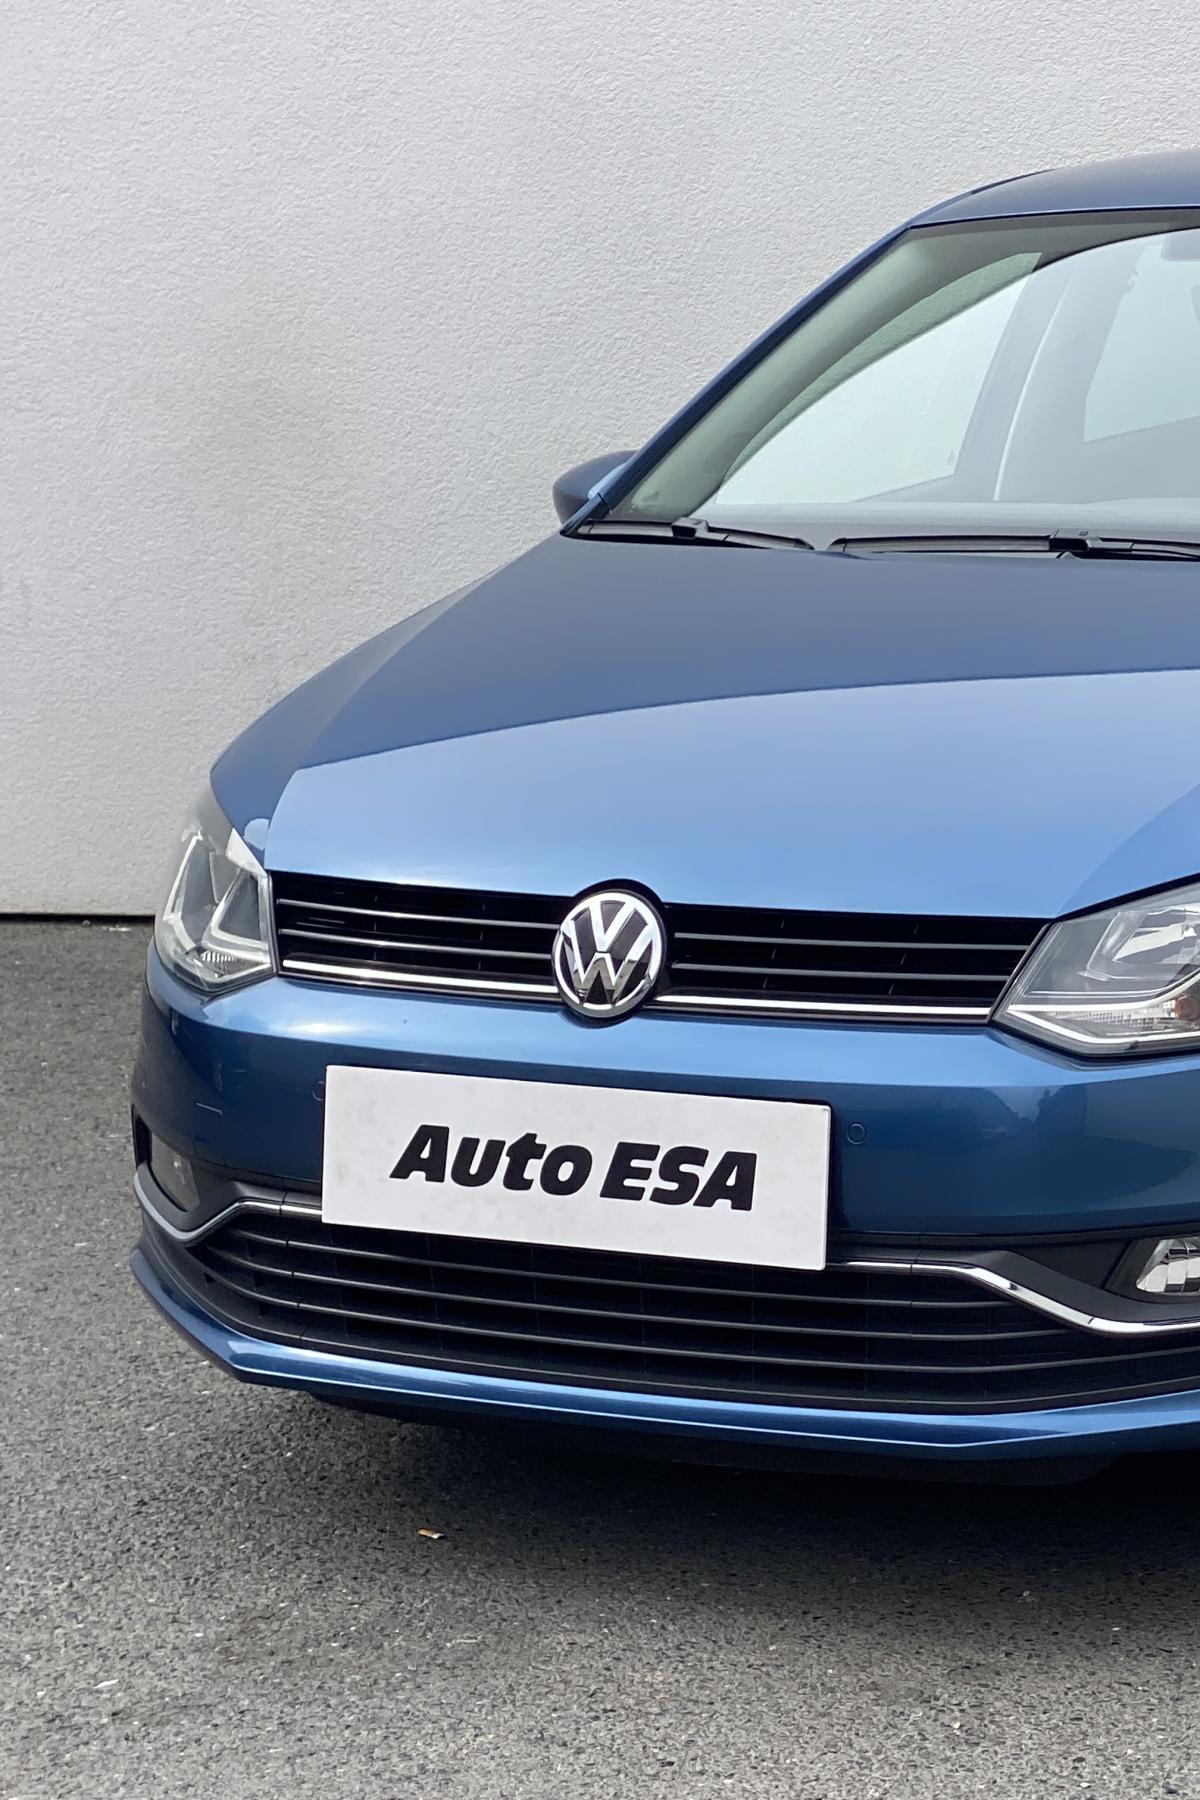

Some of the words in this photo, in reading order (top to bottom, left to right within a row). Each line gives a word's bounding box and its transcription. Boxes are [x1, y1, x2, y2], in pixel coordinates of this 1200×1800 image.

[558, 896, 659, 1005] VW
[389, 1124, 593, 1196] Auto
[599, 1141, 758, 1212] ESA
